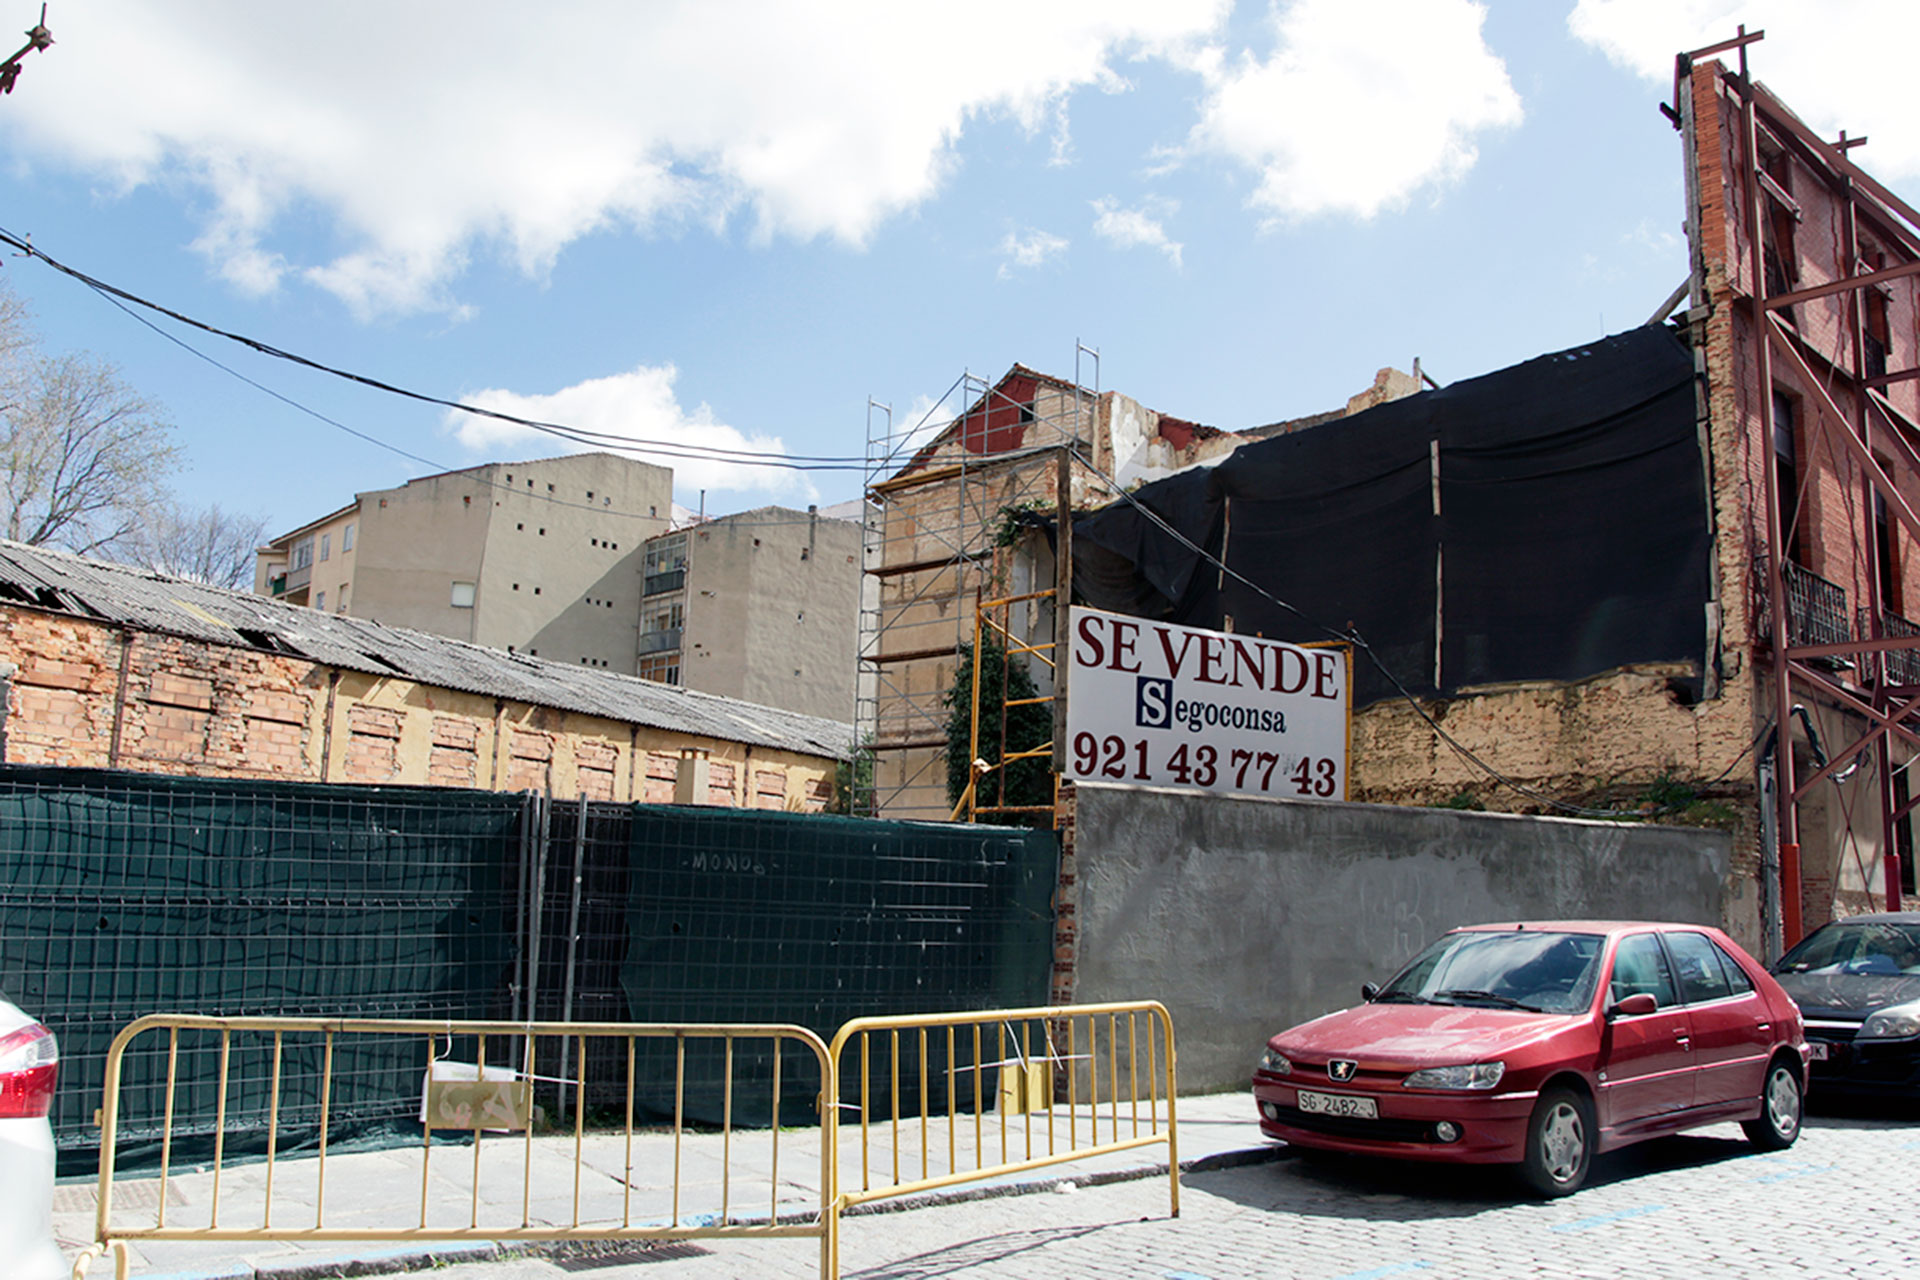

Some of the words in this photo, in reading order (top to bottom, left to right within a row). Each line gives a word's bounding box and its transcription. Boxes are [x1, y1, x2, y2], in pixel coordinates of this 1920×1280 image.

[1076, 615, 1142, 673] SE
[1153, 626, 1339, 700] VENDE
[1140, 680, 1286, 733] Segoconsa
[1073, 732, 1151, 780] 921
[1166, 743, 1218, 787] 43
[1231, 749, 1279, 791] 77
[1290, 756, 1336, 797] 43
